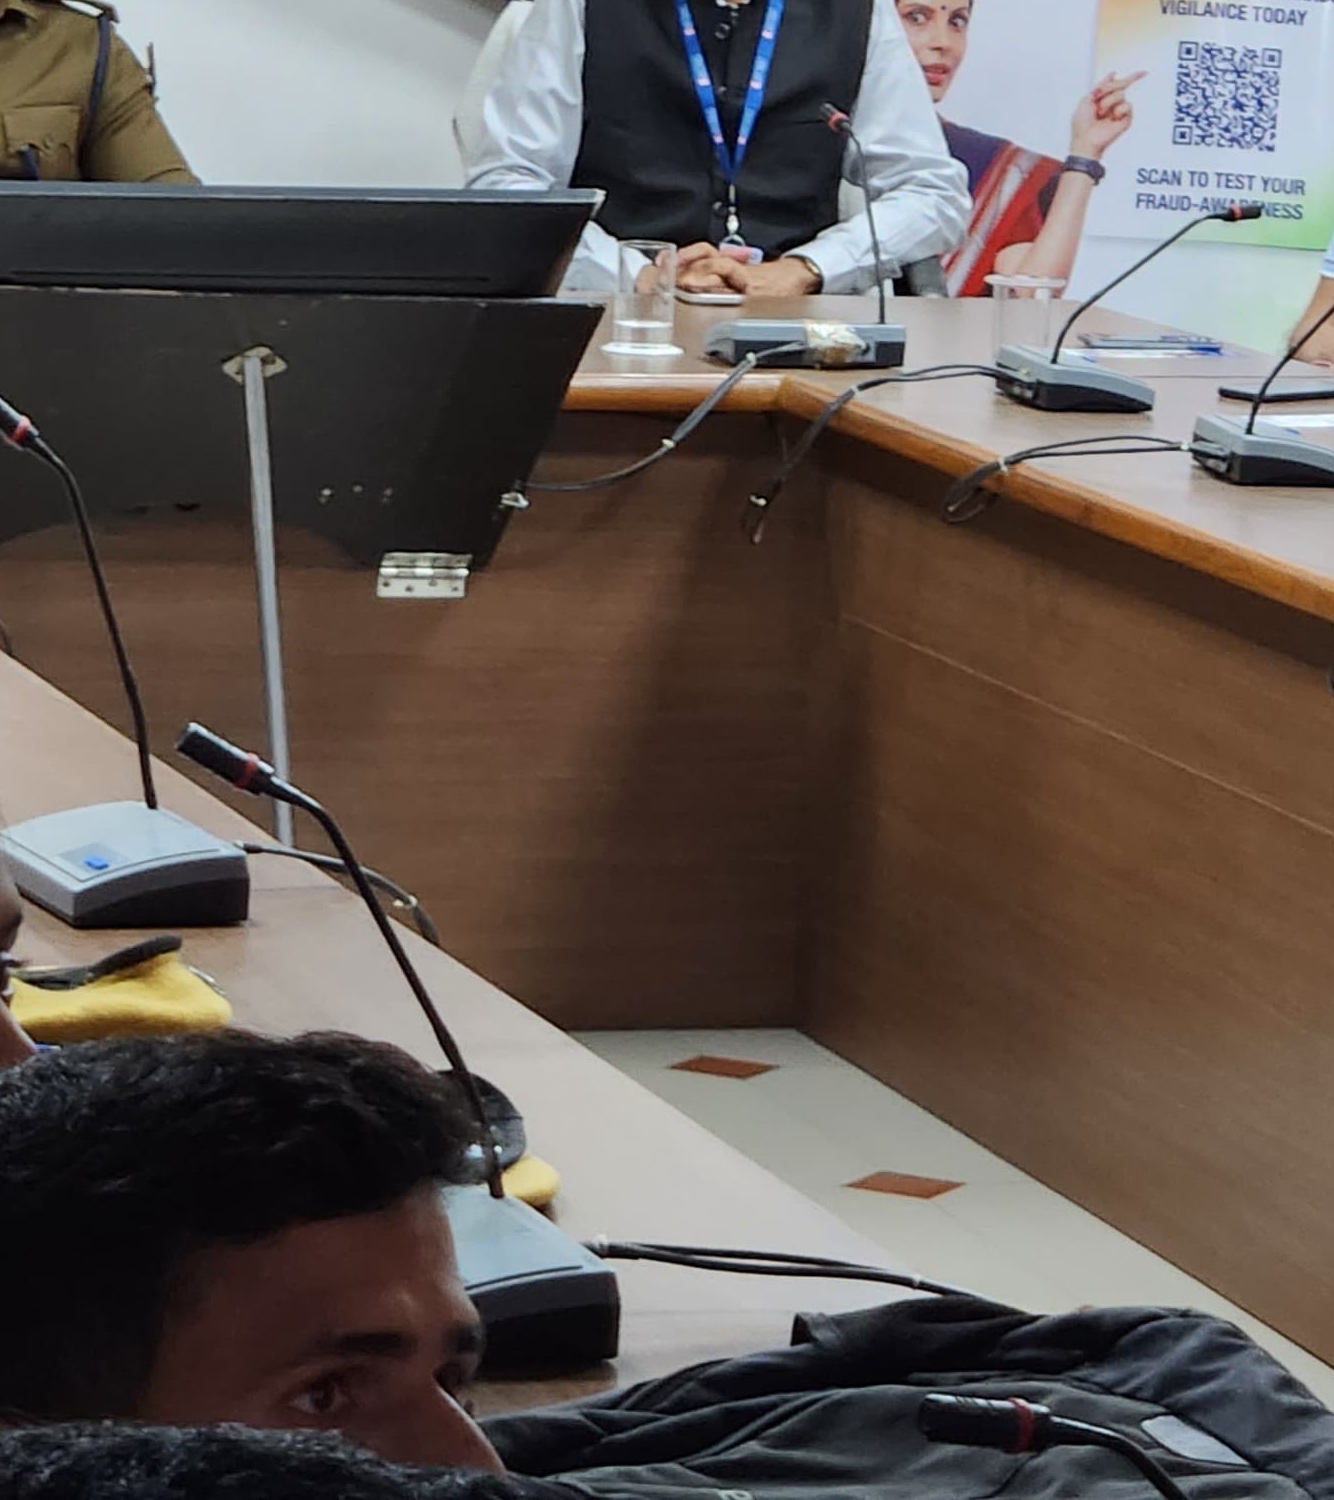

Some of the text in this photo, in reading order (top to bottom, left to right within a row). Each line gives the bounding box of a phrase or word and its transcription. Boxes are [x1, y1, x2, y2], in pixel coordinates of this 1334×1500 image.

[1159, 0, 1308, 26] VIGILANCE TODAY
[1136, 167, 1306, 196] SCAN TO TEST YOUR
